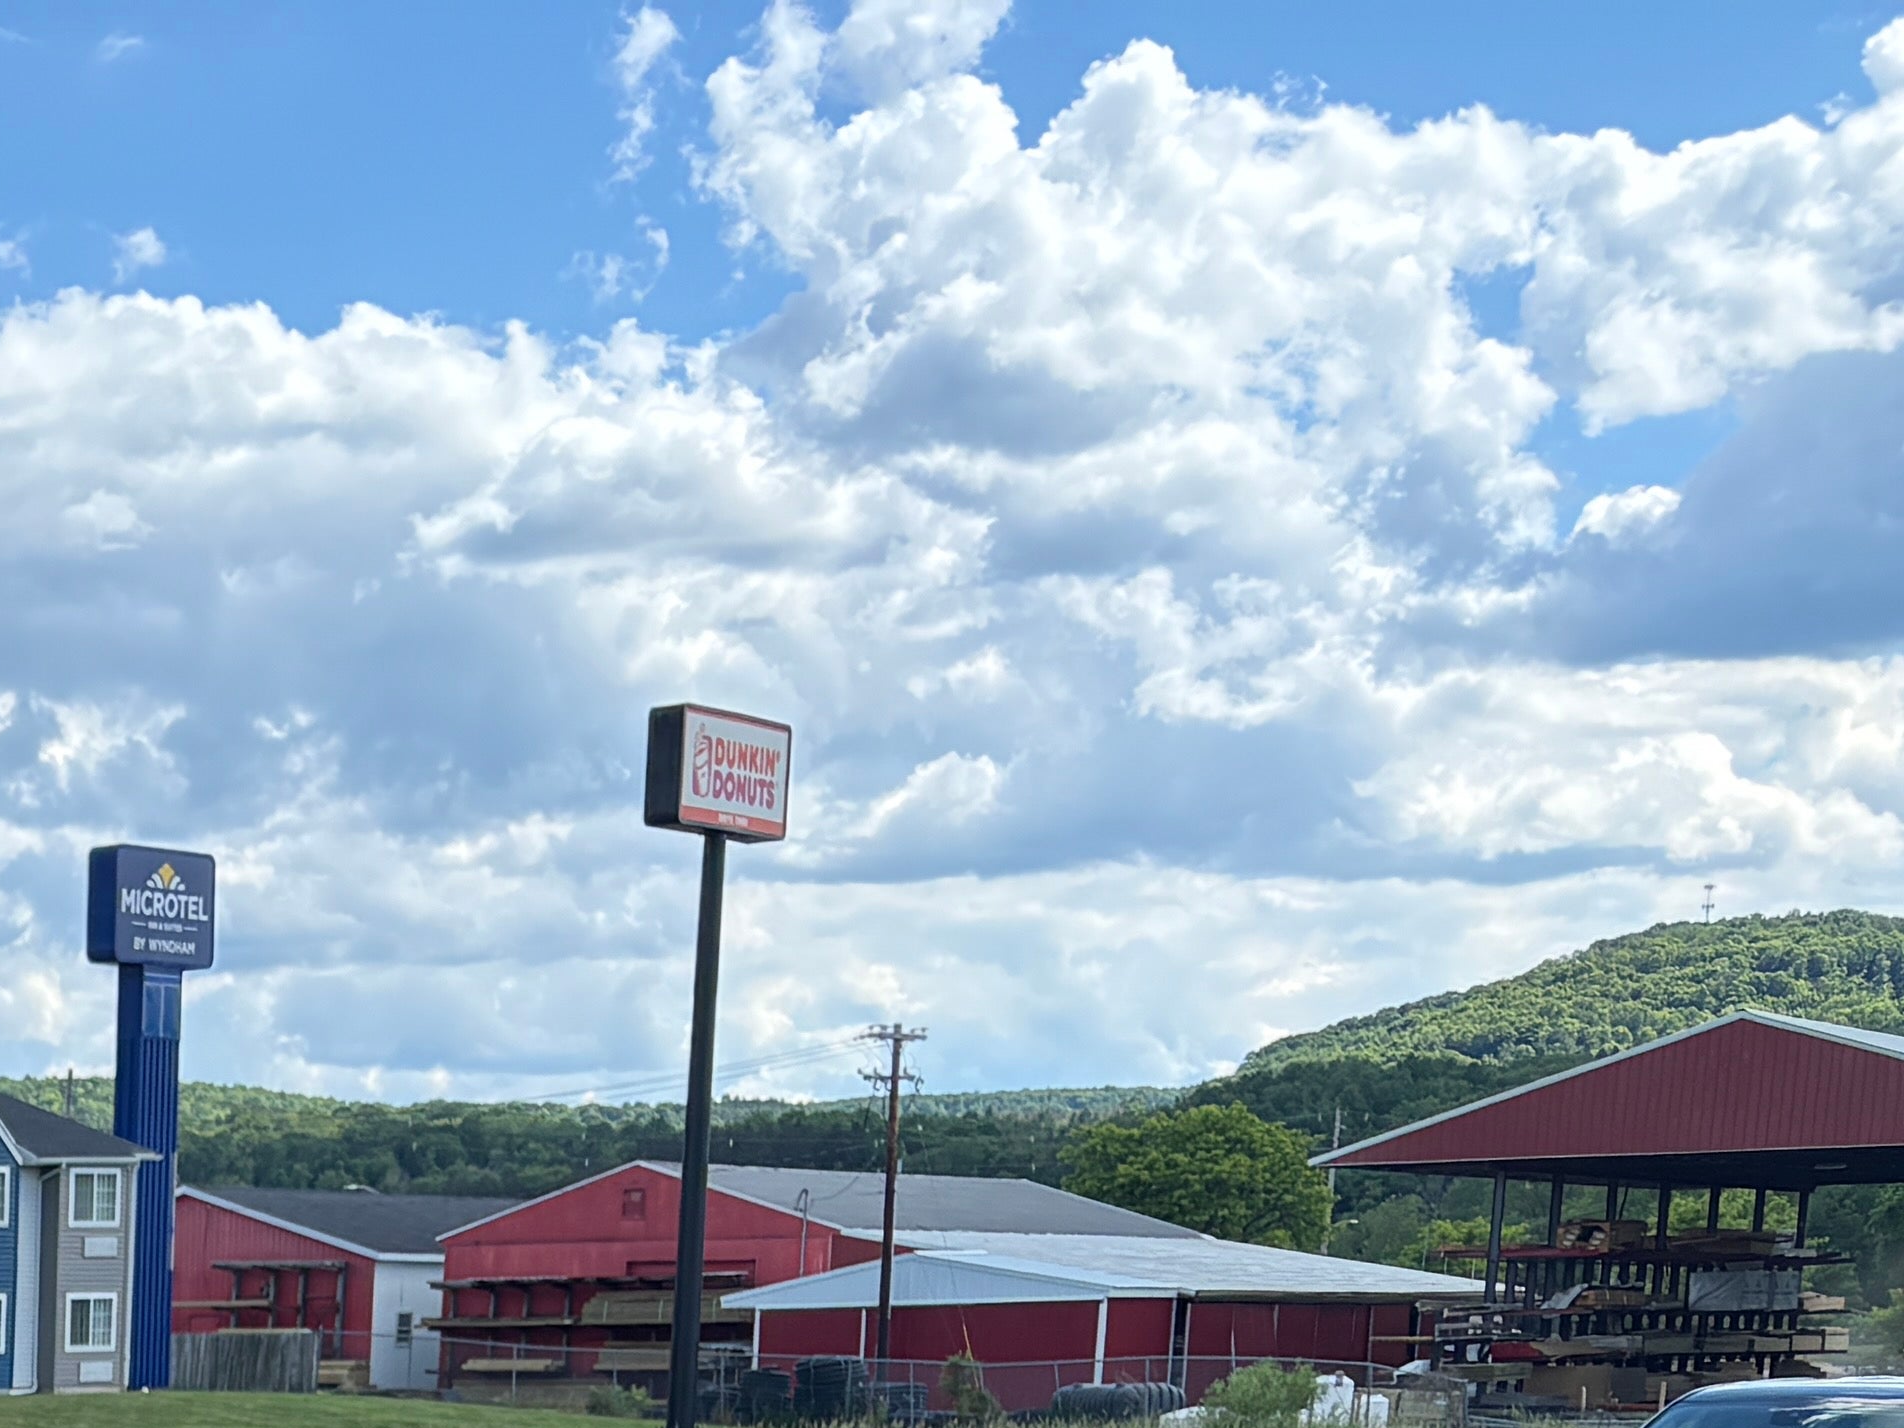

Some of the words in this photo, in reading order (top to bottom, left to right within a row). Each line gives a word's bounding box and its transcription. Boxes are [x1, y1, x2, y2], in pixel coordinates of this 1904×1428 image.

[714, 737, 782, 778] DUNKIN'
[712, 769, 776, 810] DONUTS
[120, 888, 209, 921] MICROTEL
[133, 936, 146, 951] BY
[148, 938, 196, 956] WYNDHAM
